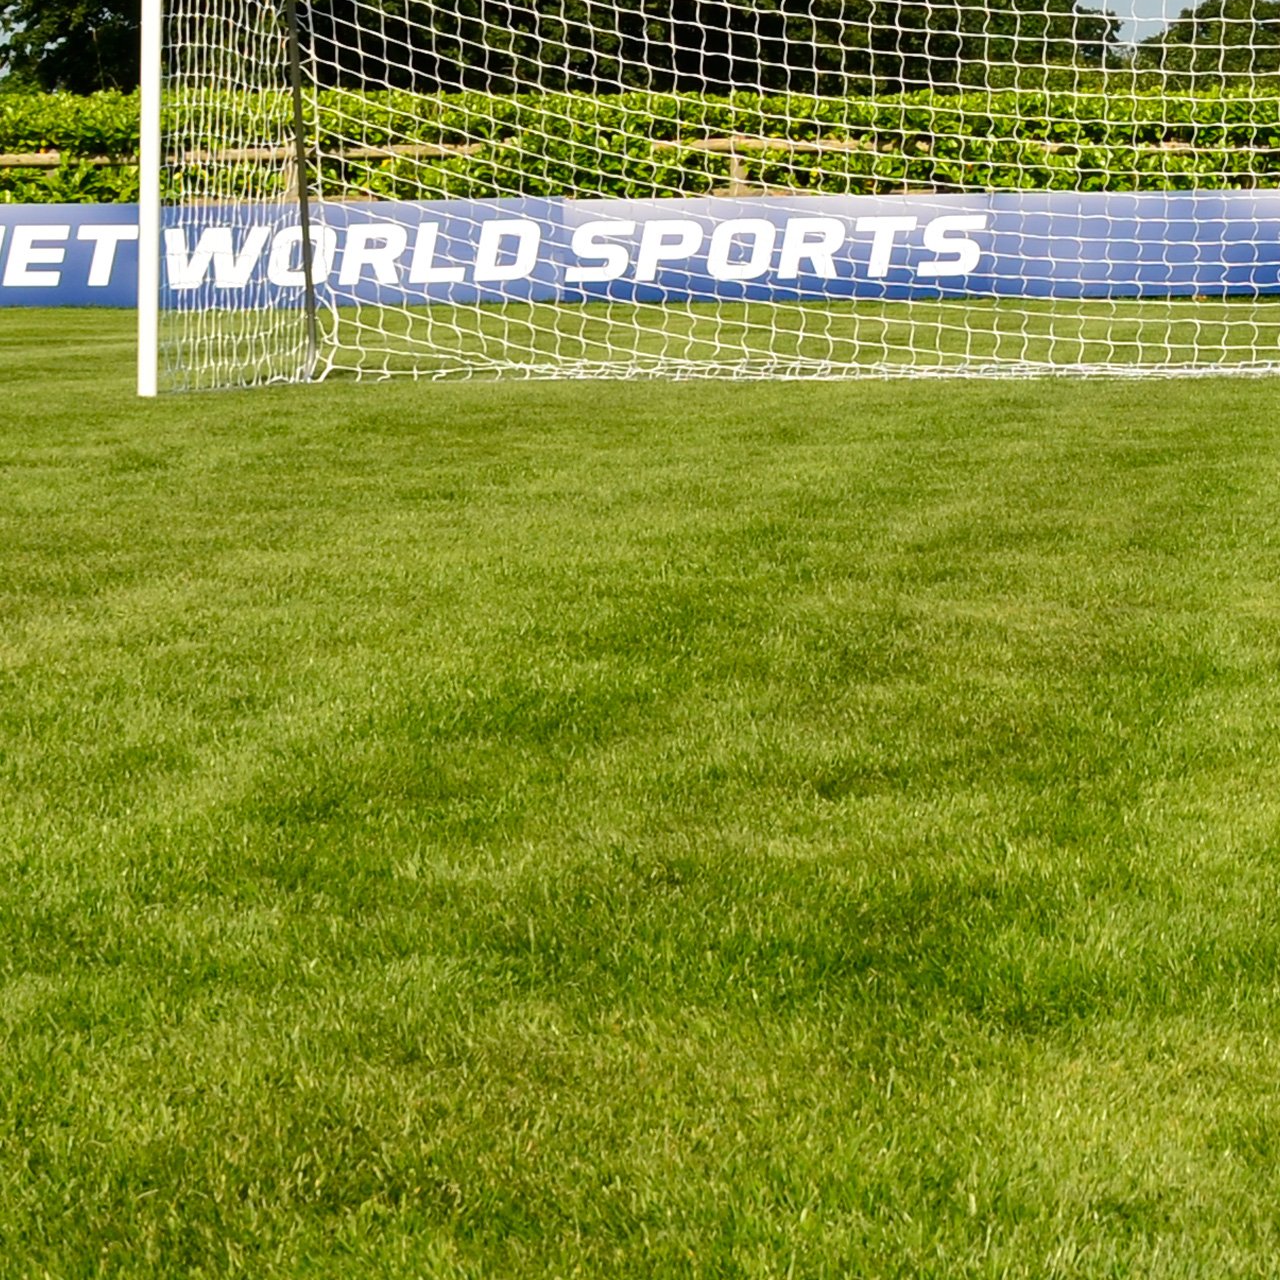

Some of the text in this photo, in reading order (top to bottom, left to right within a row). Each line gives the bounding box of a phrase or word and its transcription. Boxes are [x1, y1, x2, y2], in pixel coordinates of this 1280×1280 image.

[0, 214, 989, 290] ET WORLD SPORTS
